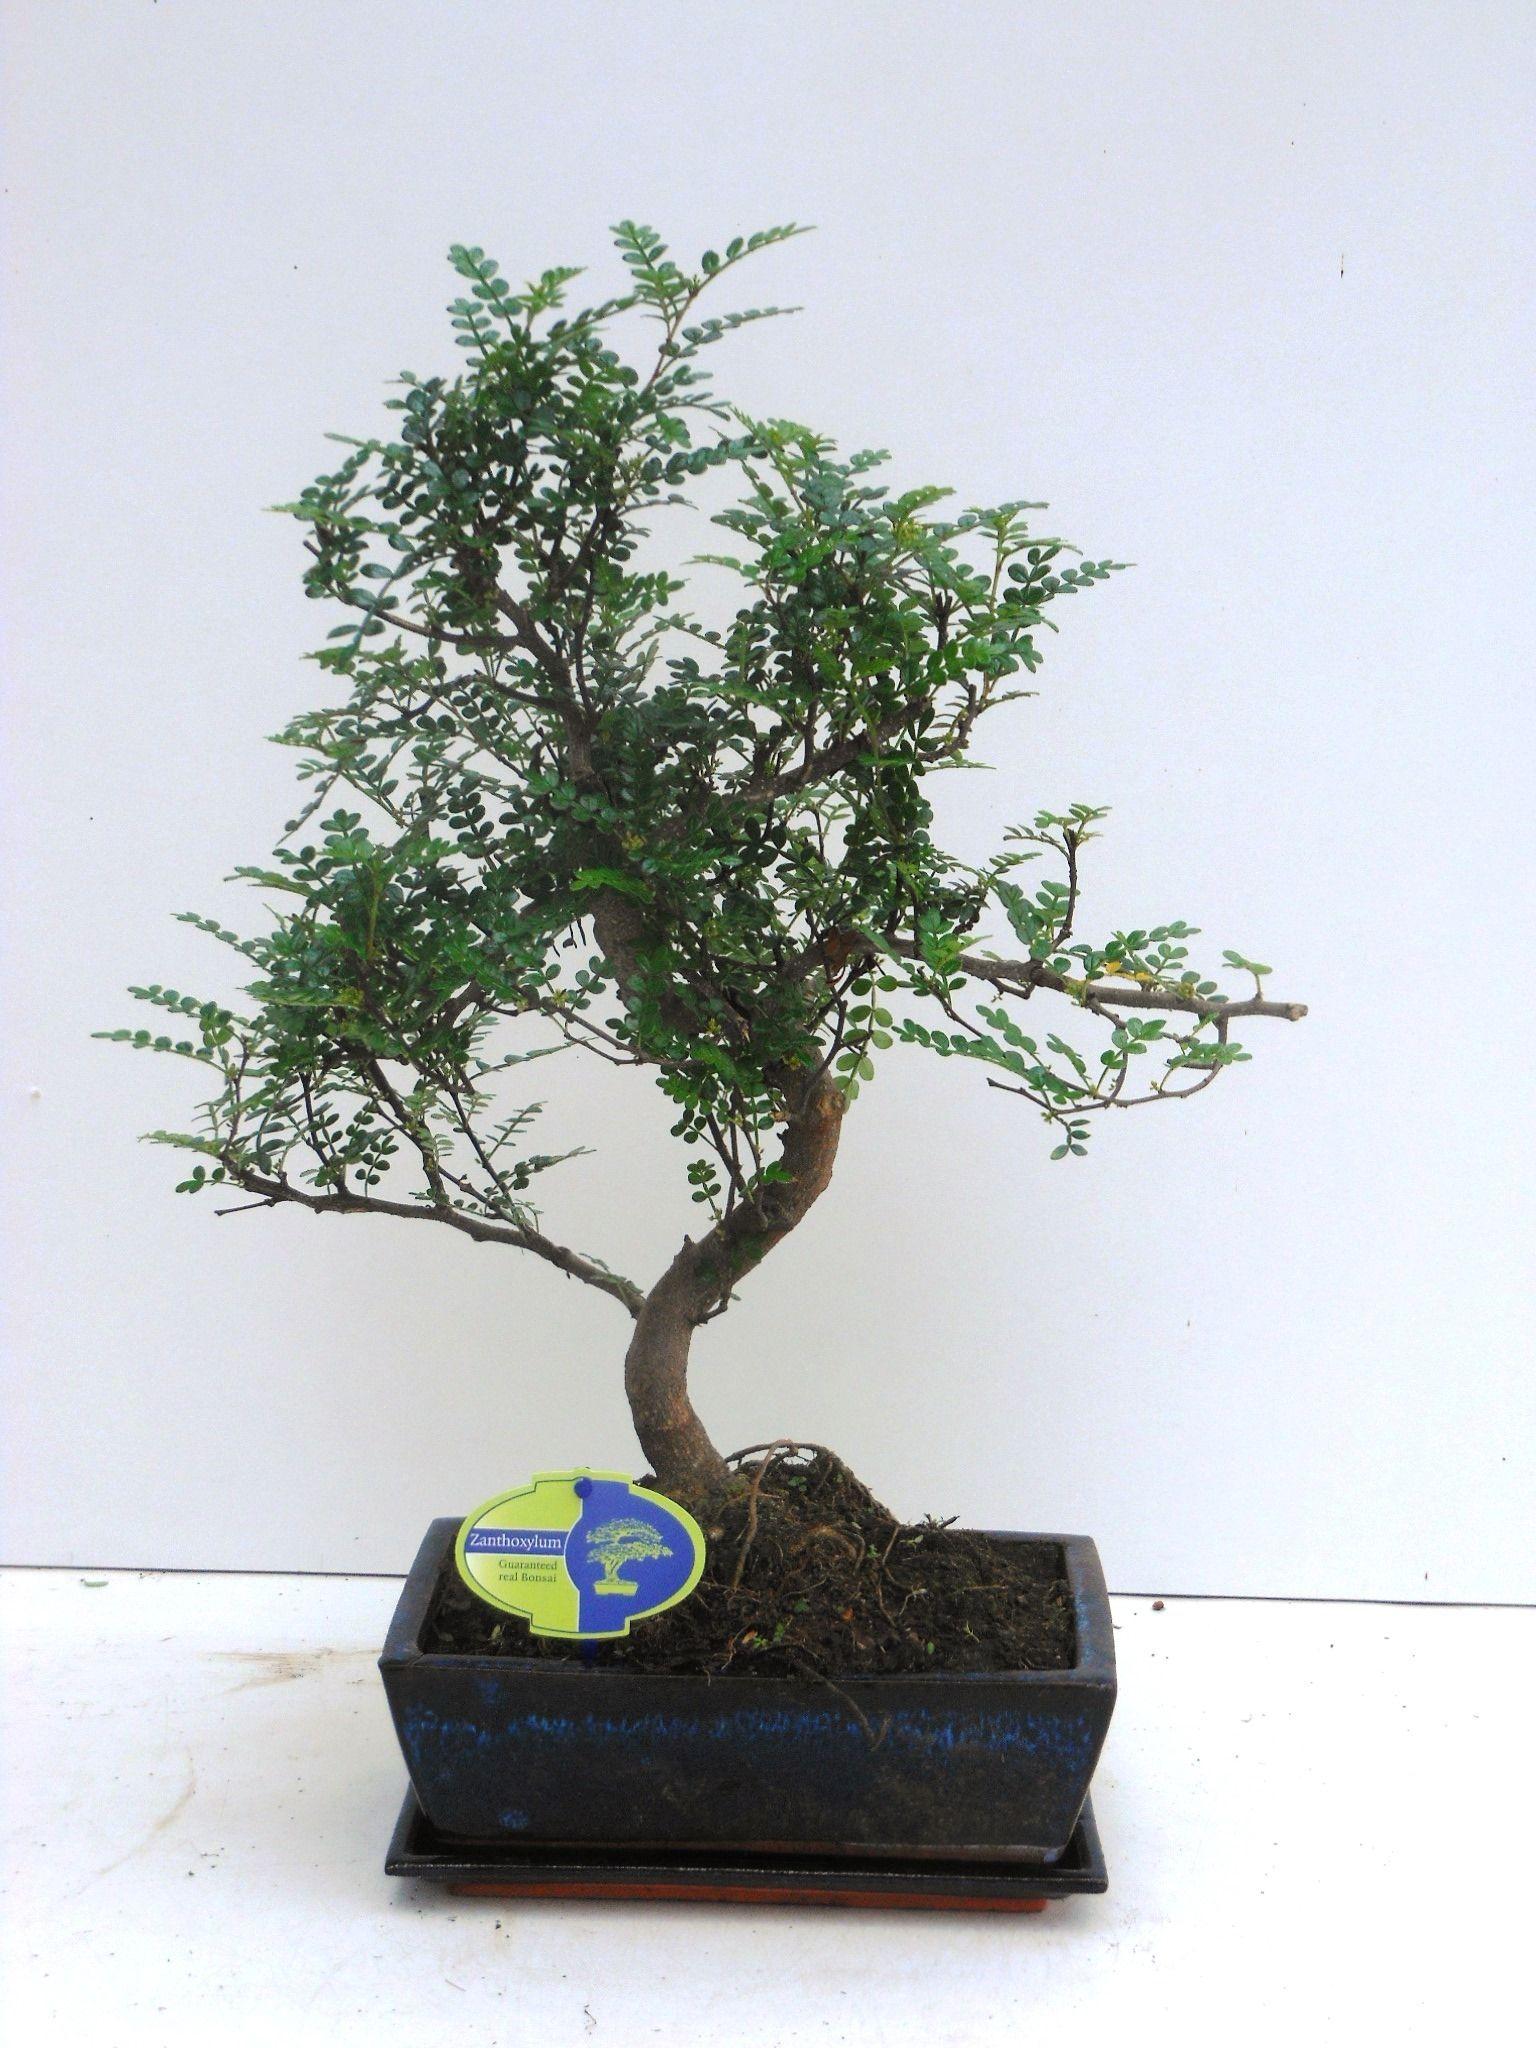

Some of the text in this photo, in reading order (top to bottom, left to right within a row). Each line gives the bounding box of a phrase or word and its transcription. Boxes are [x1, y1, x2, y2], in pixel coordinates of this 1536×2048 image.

[470, 1533, 562, 1551] Zanthoxylum
[498, 1559, 558, 1571] Guaranteed
[499, 1572, 557, 1583] real Bonsai
